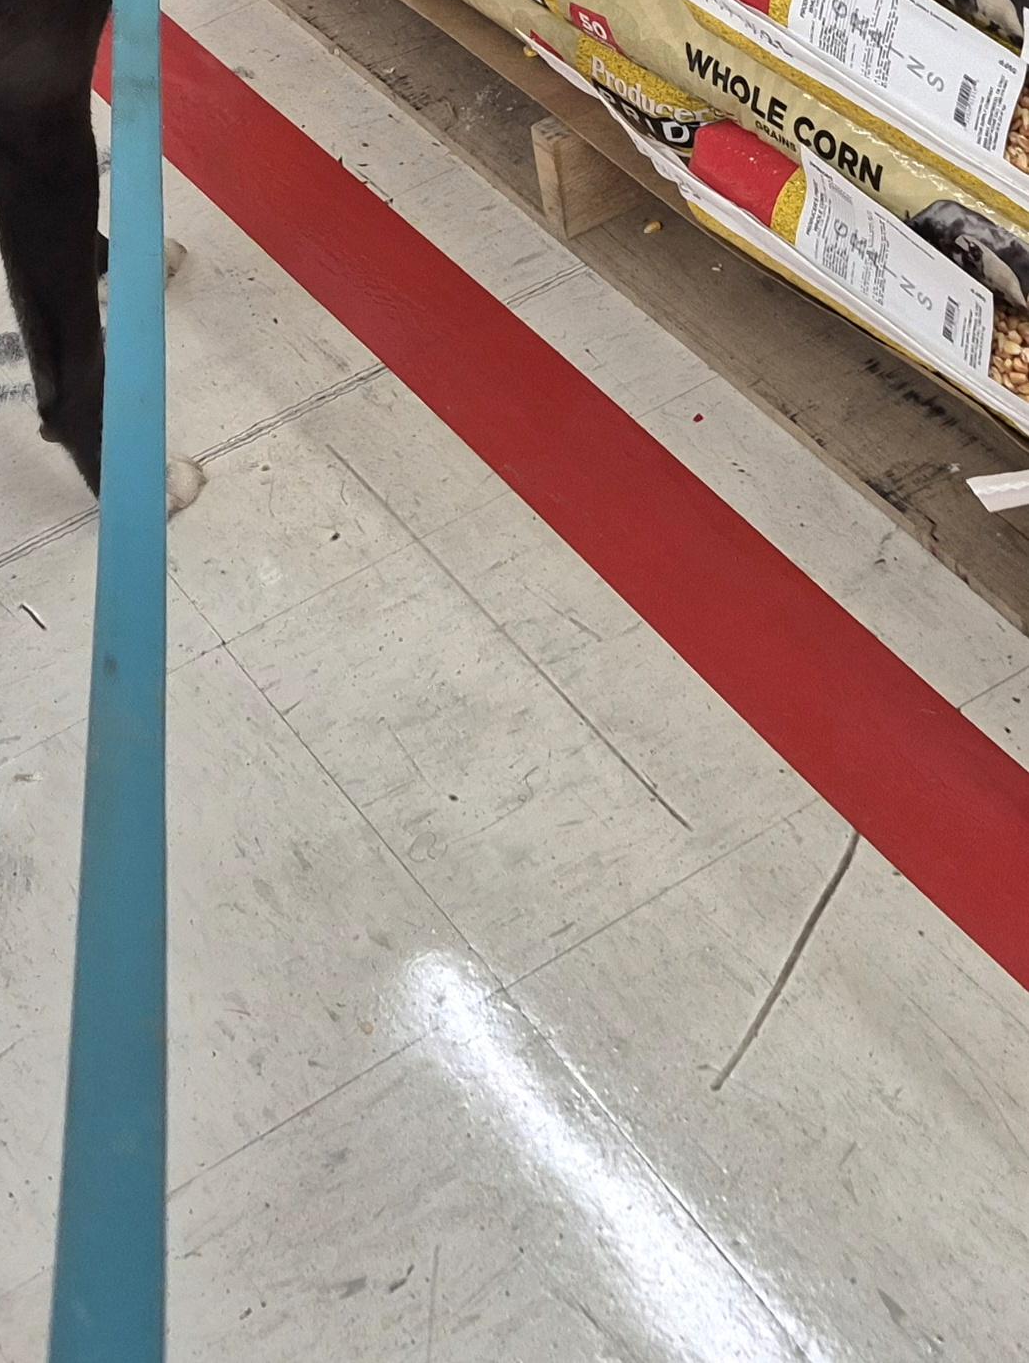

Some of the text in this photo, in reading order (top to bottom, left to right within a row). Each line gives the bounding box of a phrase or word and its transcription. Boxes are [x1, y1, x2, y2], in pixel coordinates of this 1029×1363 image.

[578, 10, 608, 41] 50
[686, 42, 884, 192] WHOLE CORN
[755, 119, 798, 153] GRAINS
